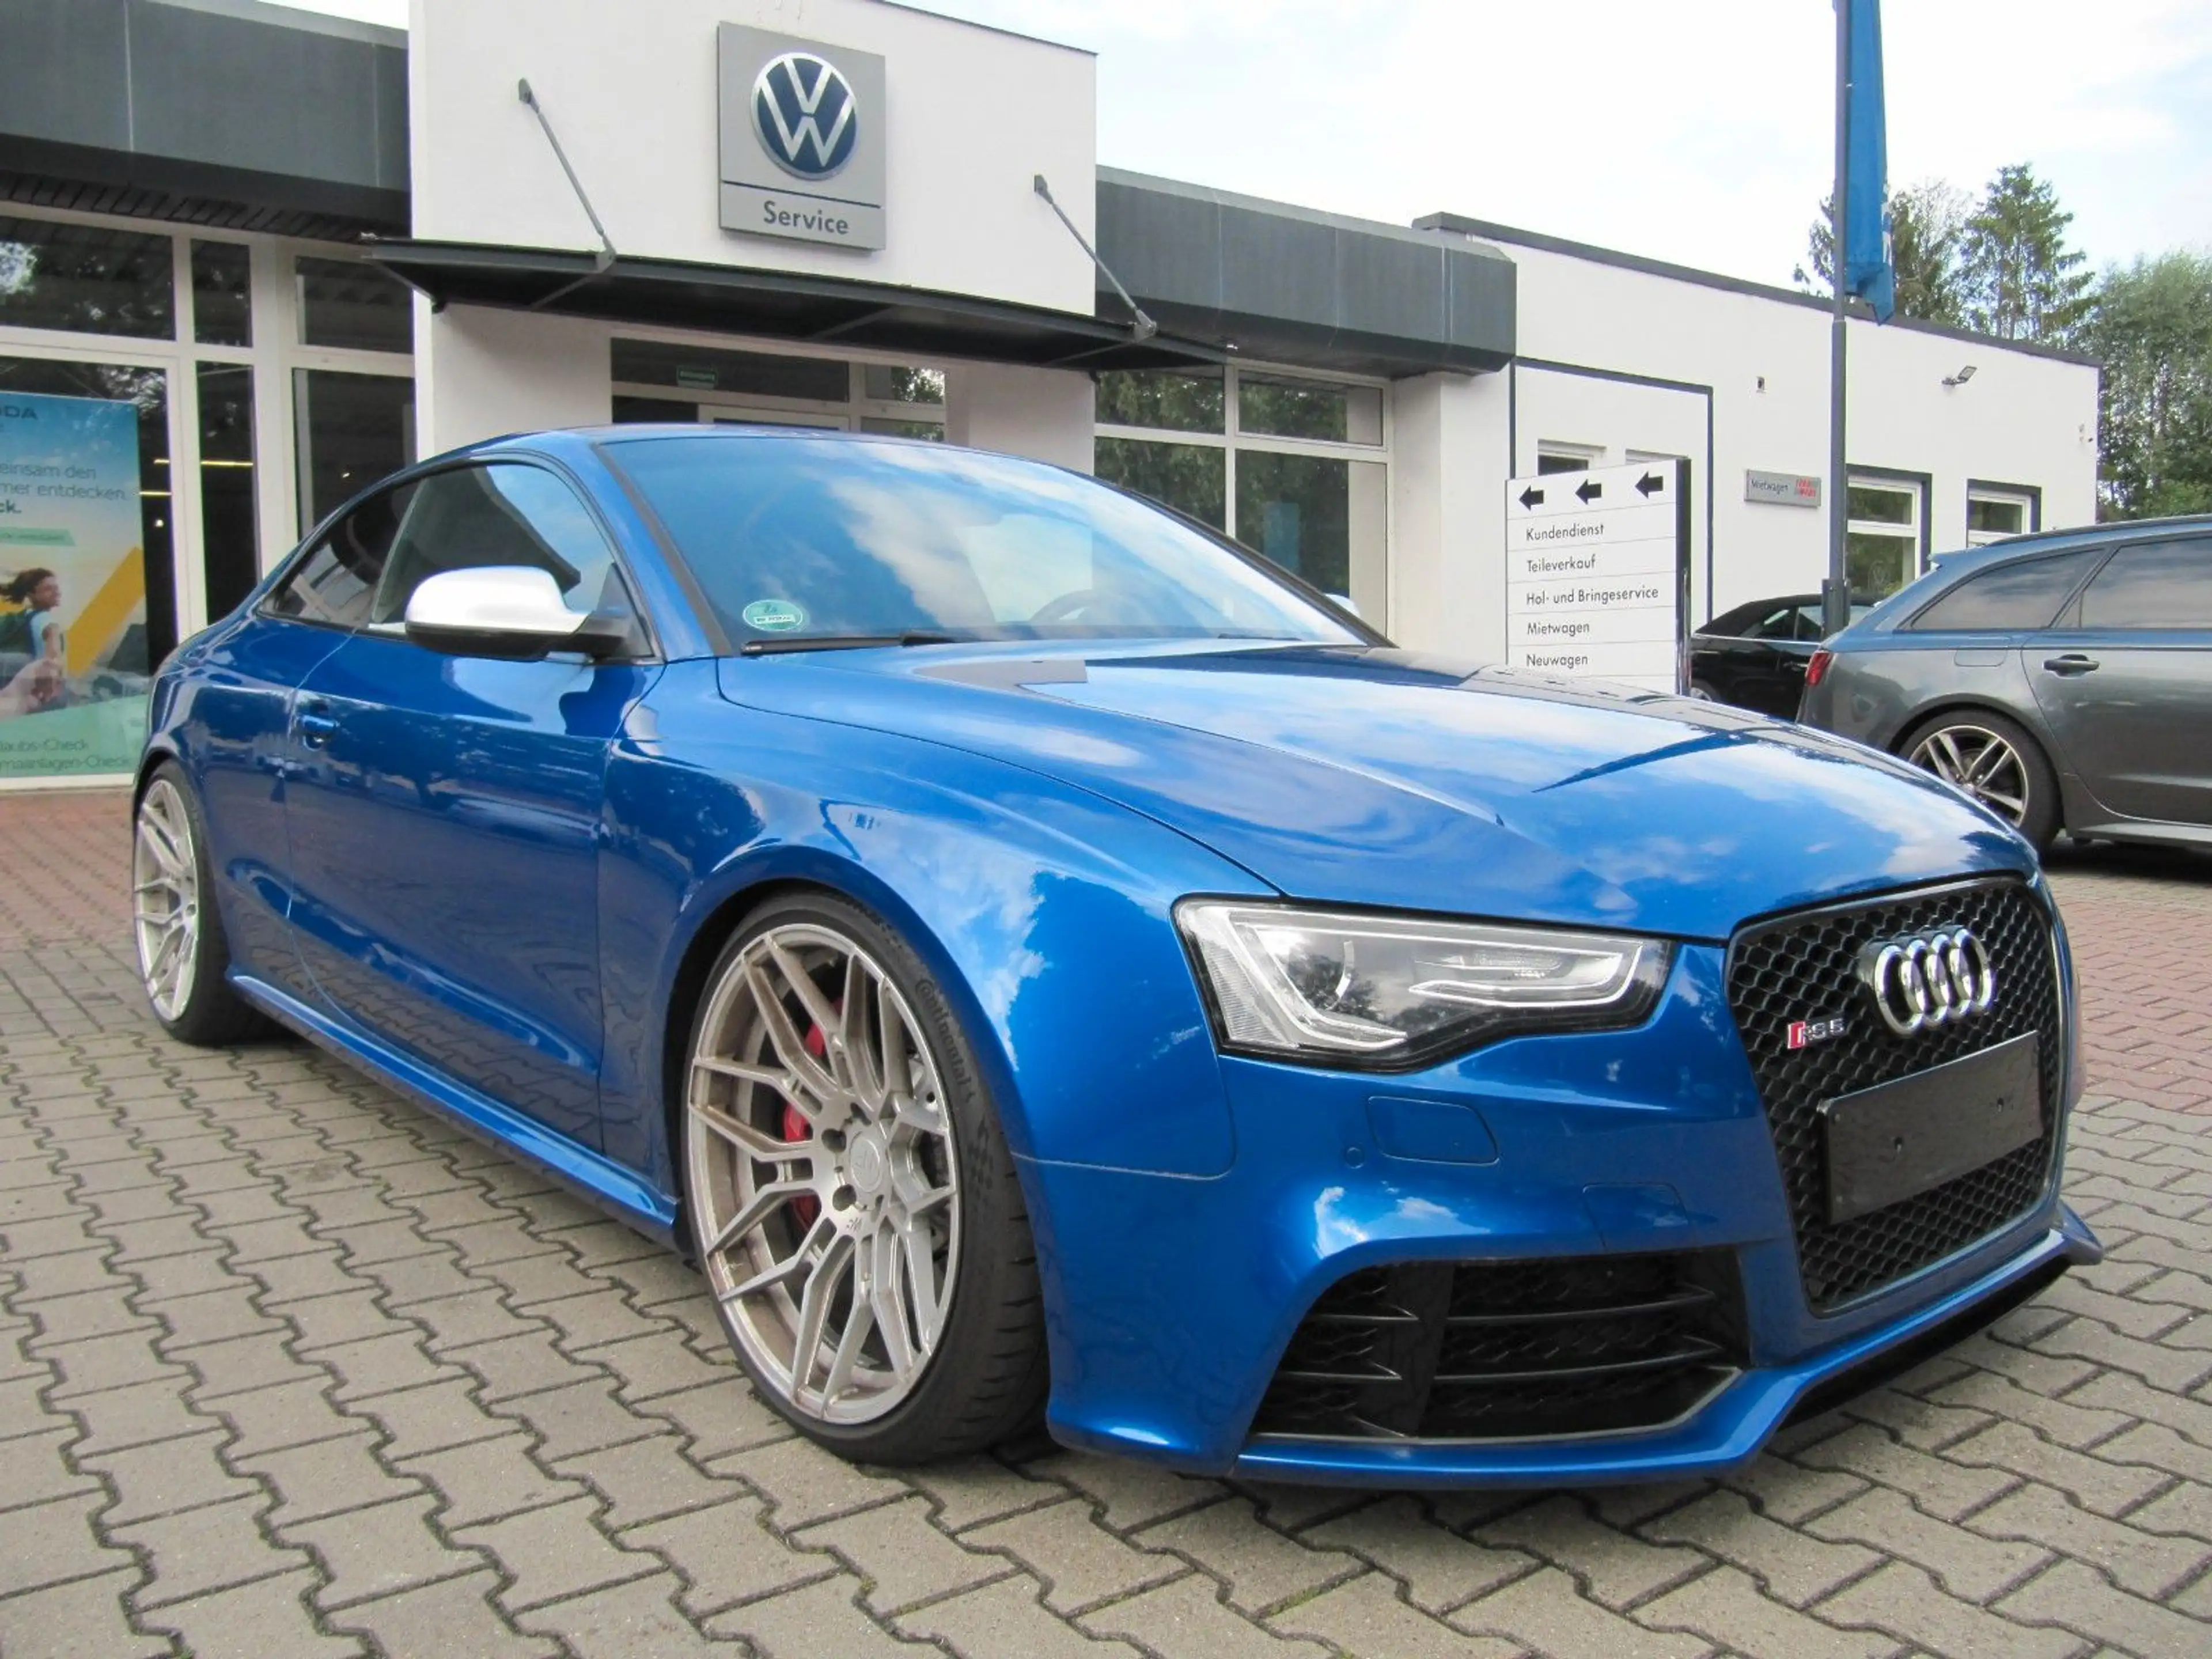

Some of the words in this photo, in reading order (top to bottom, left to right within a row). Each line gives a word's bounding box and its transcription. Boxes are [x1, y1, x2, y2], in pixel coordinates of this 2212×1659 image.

[764, 200, 849, 234] Service
[0, 405, 38, 419] DA
[65, 465, 96, 479] den
[1526, 524, 1604, 541] Kundendienst
[1527, 554, 1596, 571] Teileverkauf
[1526, 590, 1550, 604] Hol-
[1553, 589, 1574, 603] und
[1578, 585, 1659, 605] Bringeservice
[1527, 622, 1590, 637] Mietwagen
[1526, 653, 1588, 669] Neuwagen
